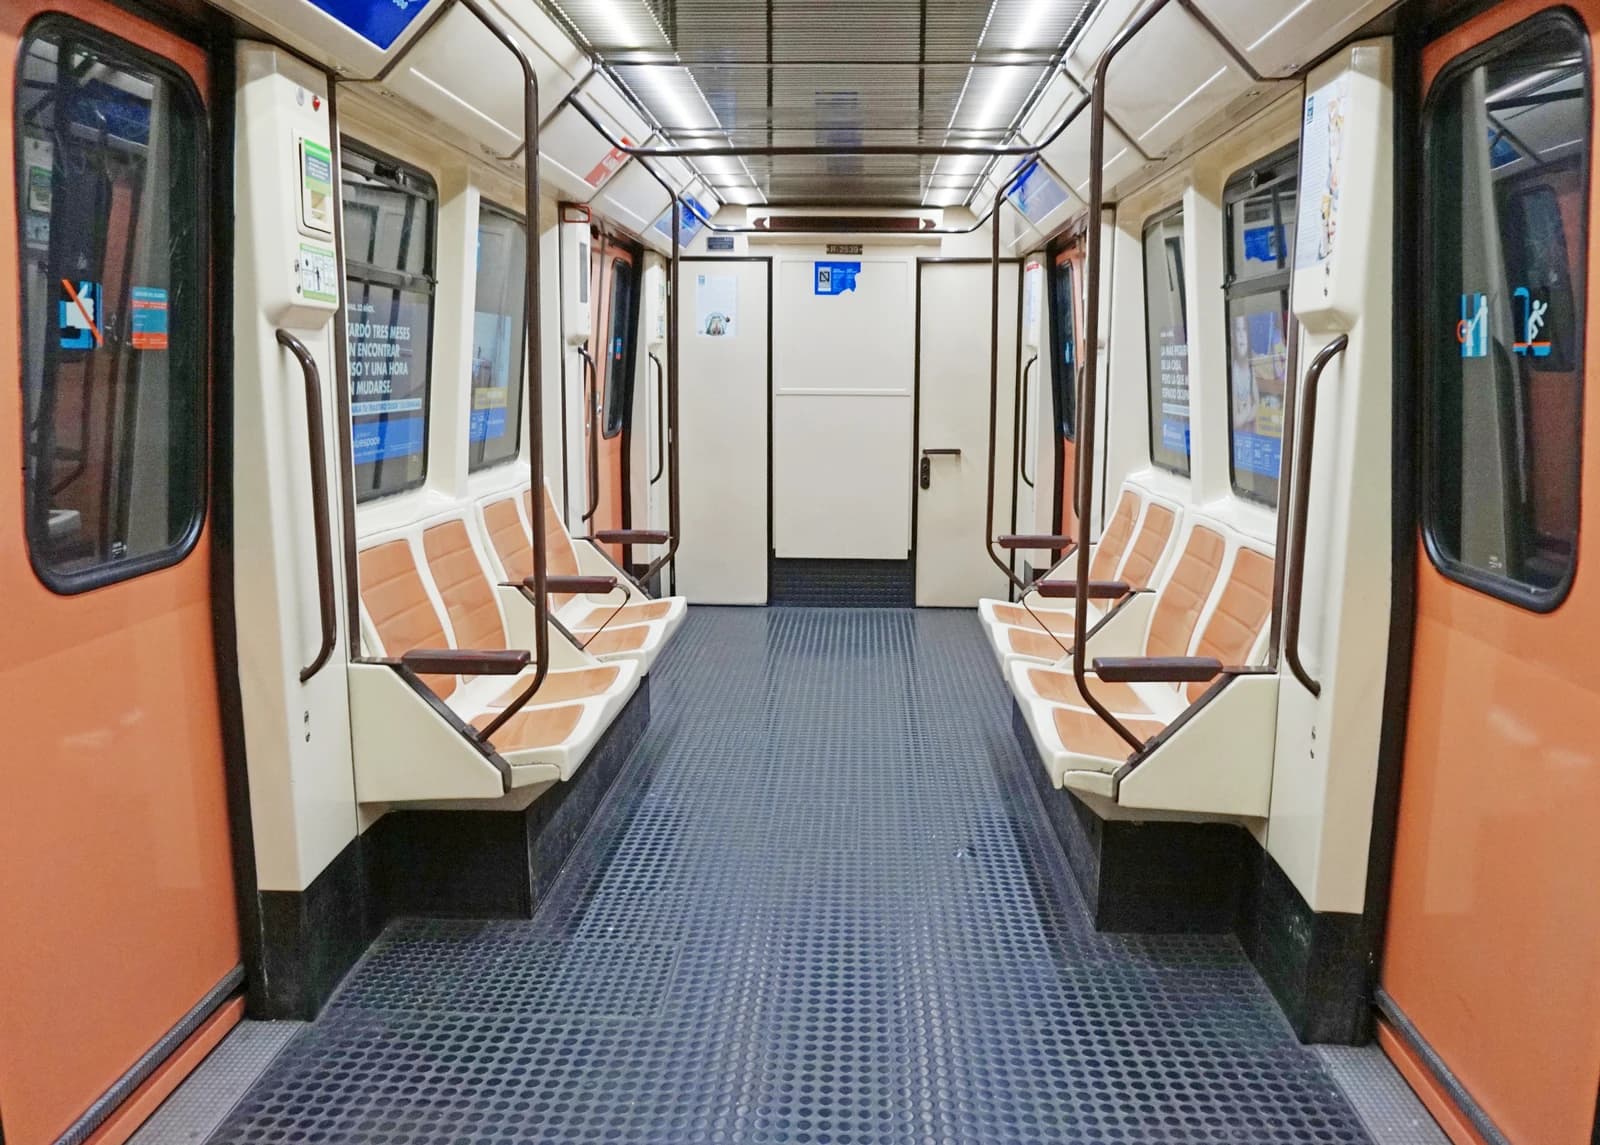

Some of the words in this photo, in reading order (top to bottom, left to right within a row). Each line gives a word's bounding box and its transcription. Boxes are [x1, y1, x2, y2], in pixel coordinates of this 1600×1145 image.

[373, 324, 388, 339] TRES
[389, 326, 410, 340] MESES
[357, 343, 400, 358] ENCONTRAR
[364, 362, 370, 376] Y
[371, 362, 387, 376] UNA
[389, 362, 408, 376] HORA
[356, 380, 392, 395] MUDARSE.
